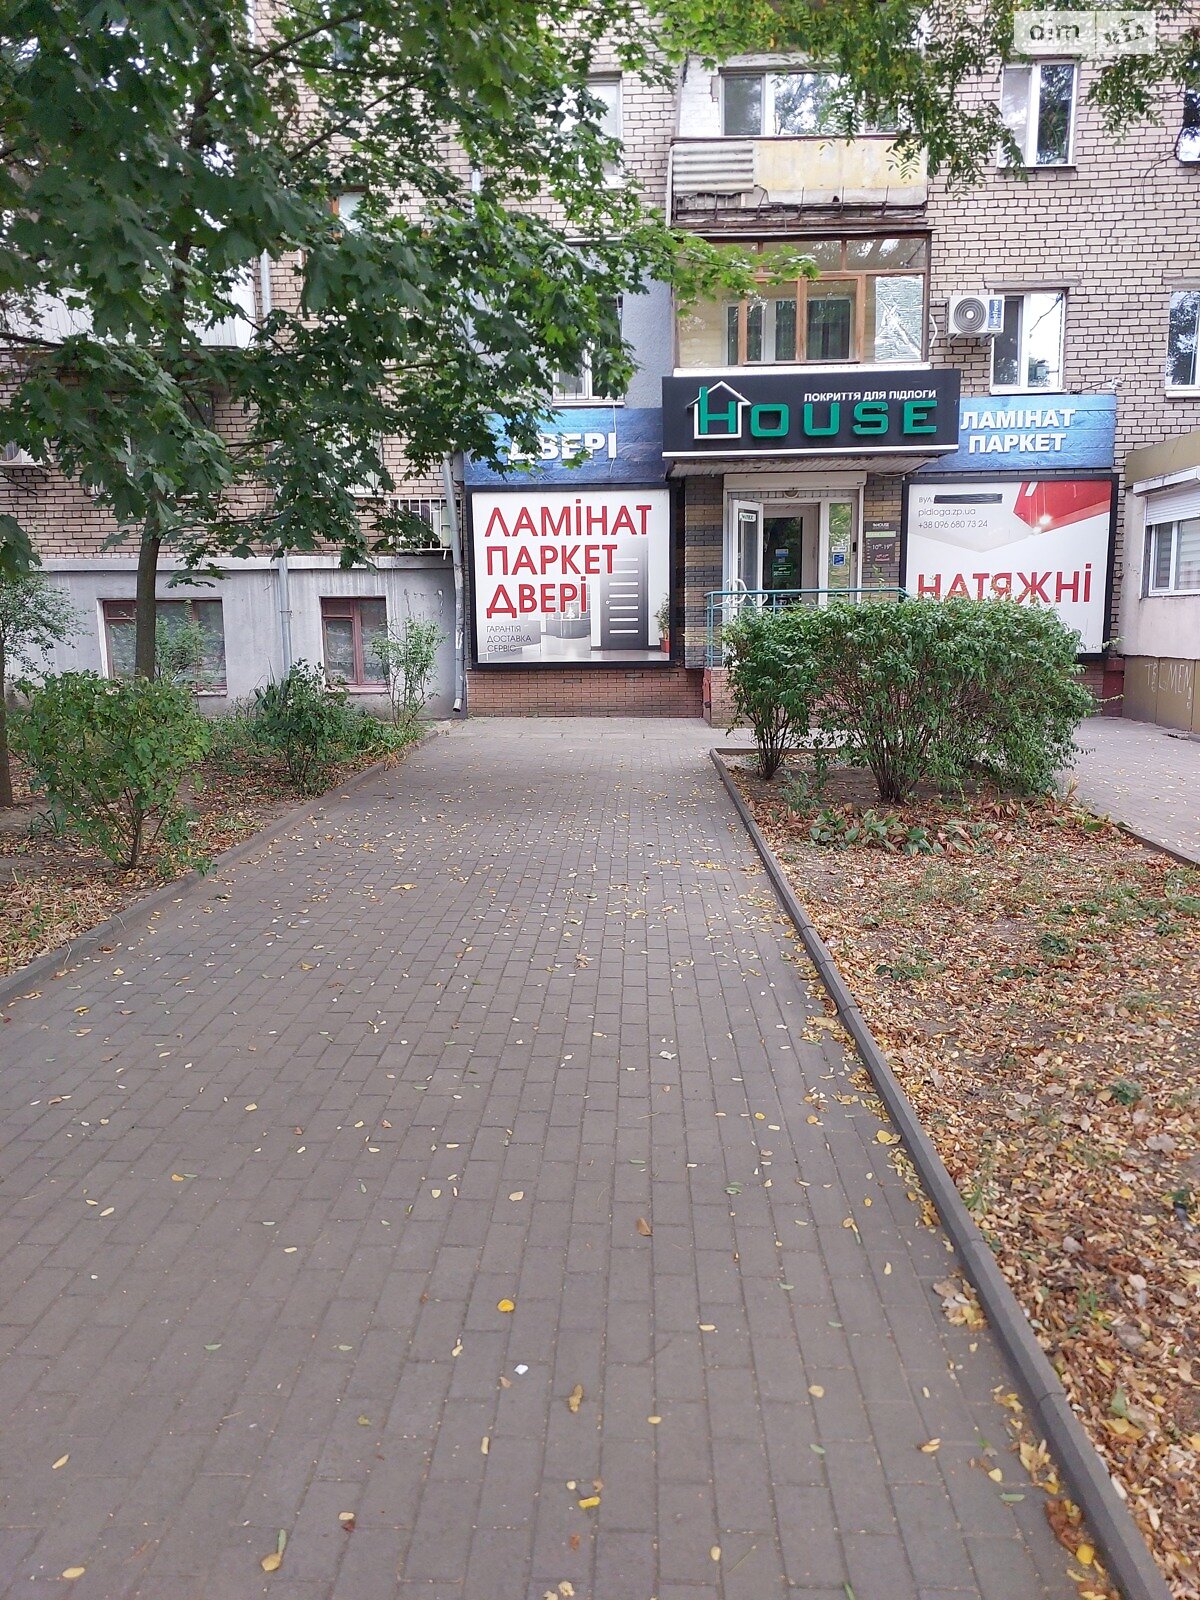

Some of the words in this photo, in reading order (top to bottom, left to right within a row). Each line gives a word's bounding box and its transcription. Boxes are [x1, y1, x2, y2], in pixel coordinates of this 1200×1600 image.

[804, 391, 860, 402] ПОКРИТТЯ
[863, 390, 886, 401] ДЛЯ
[889, 389, 937, 400] ПІДЛОГИ
[699, 386, 938, 437] HOUSE
[960, 408, 1076, 430] ЛАМІНАТ
[968, 433, 1067, 453] ПАРКЕТ
[918, 521, 932, 529] +38
[934, 521, 949, 529] 096
[951, 520, 965, 528] 680
[967, 520, 977, 528] 73
[978, 520, 988, 528] 24
[486, 544, 618, 576] ПАРКЕТ
[486, 625, 522, 633] ГАРАНТІЯ
[486, 634, 532, 643] ДОСТАВКА
[487, 644, 517, 653] СЕРВІС
